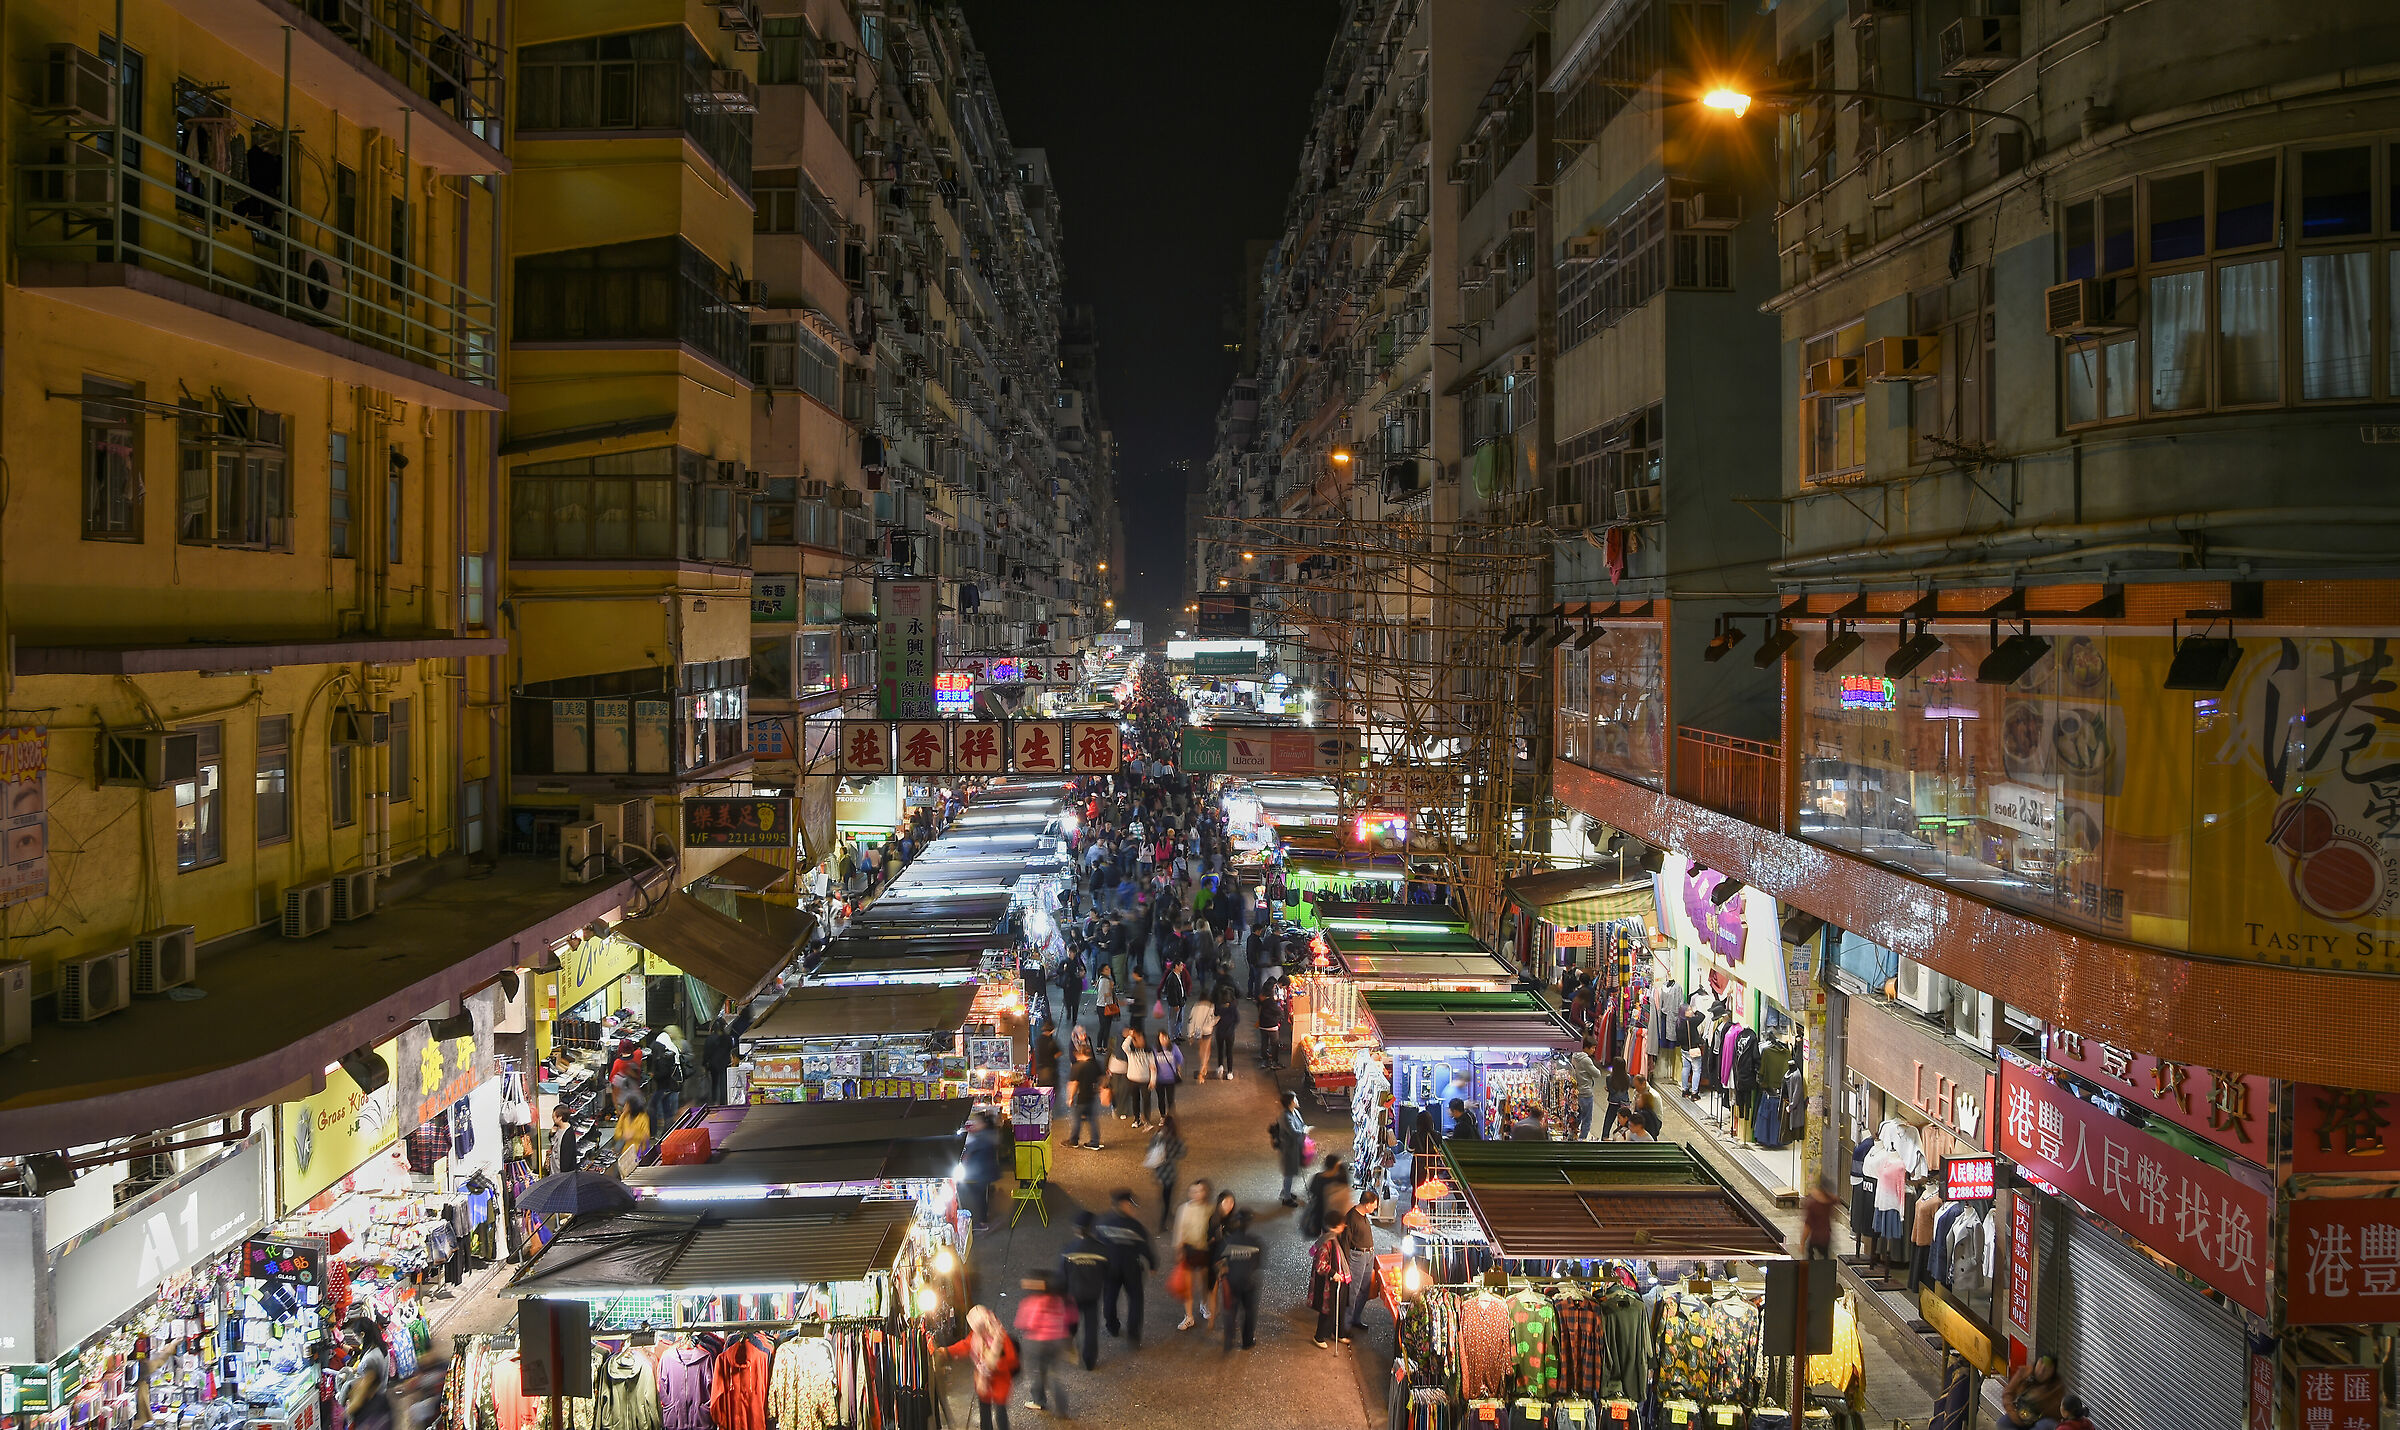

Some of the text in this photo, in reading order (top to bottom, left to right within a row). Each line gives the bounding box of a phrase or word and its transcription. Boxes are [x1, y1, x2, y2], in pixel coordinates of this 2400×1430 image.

[907, 617, 924, 677] 永興隆
[1232, 756, 1265, 765] Wacoal
[690, 833, 786, 844] 1/F 2214 9995
[2245, 923, 2400, 959] TASTY ST
[318, 1108, 345, 1131] Grass
[137, 1191, 199, 1288] A1
[277, 1273, 297, 1281] GLASS
